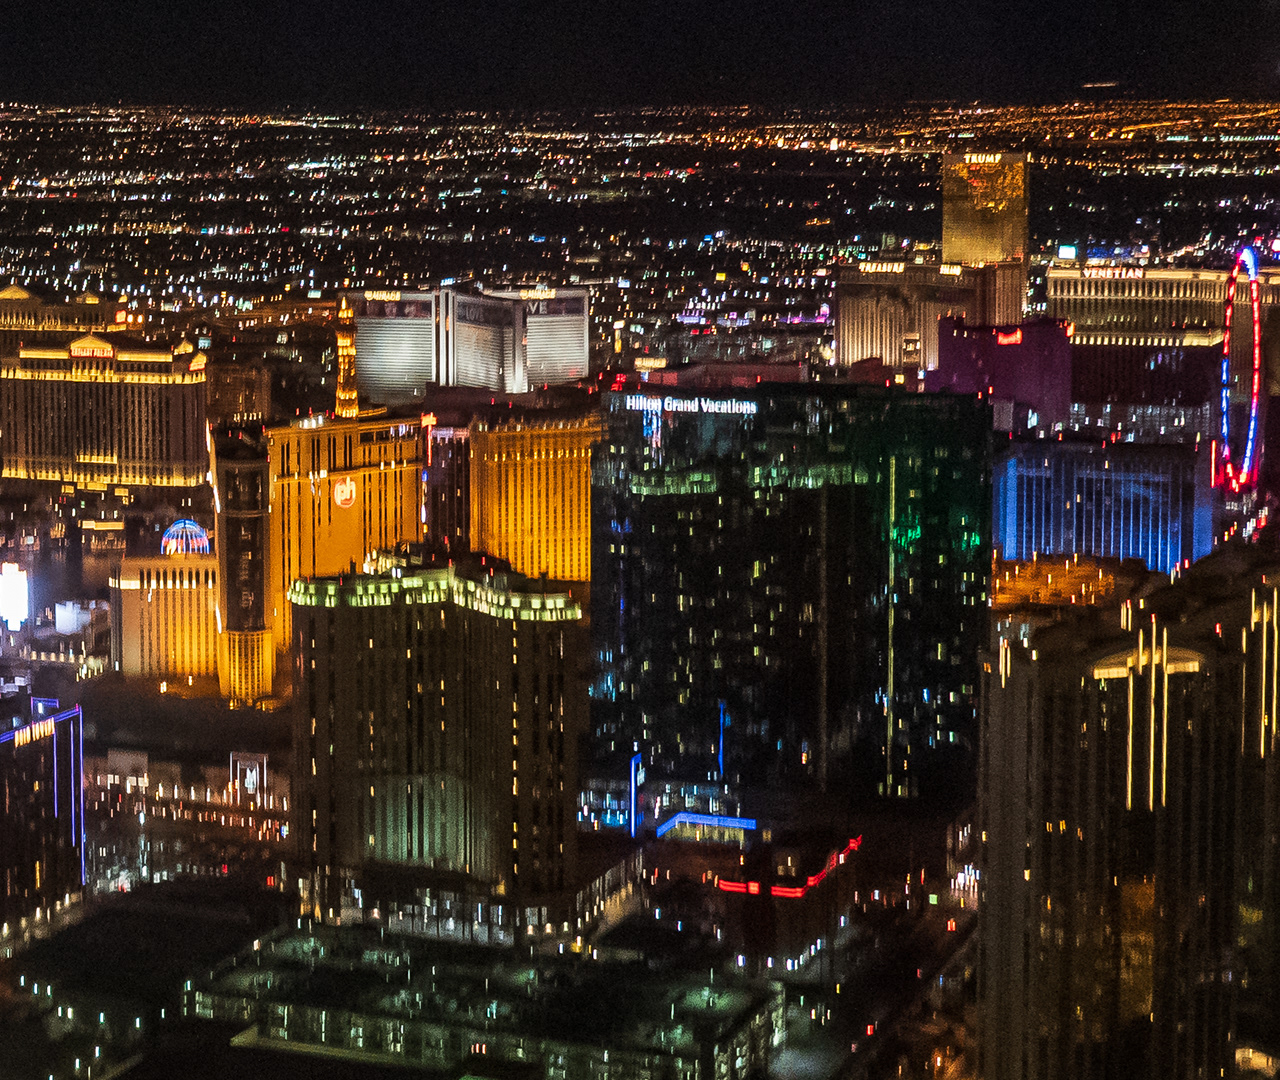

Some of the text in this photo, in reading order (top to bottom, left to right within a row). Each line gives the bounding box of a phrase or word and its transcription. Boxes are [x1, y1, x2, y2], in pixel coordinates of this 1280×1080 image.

[964, 154, 1002, 164] TRUMP
[859, 262, 905, 273] TREASURE
[1083, 268, 1144, 279] VENETIAN
[626, 395, 758, 414] Hilton Grand Vacations
